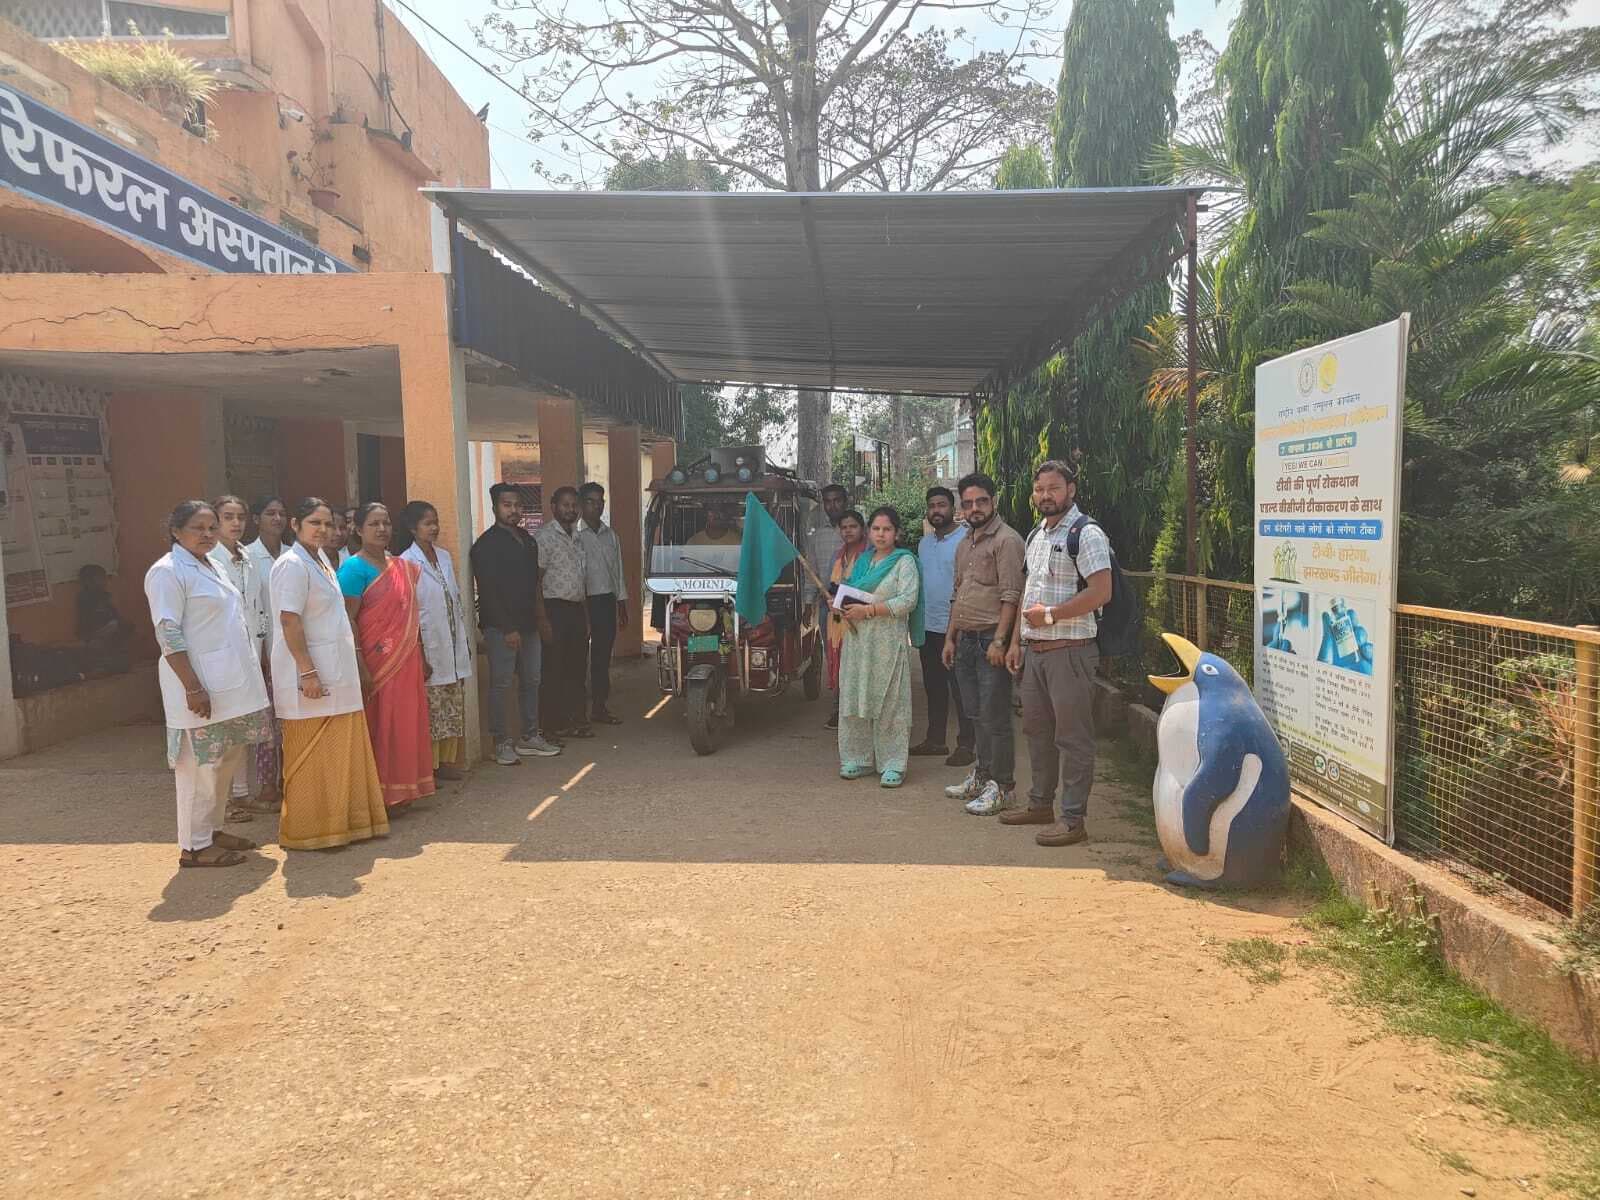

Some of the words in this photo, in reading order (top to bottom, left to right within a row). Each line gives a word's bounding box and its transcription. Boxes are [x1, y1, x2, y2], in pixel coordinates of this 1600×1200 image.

[1276, 477, 1292, 492] टीबी
[1294, 475, 1304, 490] की
[1306, 497, 1348, 513] टीकाकरण
[1349, 496, 1360, 512] के
[1361, 498, 1383, 513] साथ
[683, 579, 725, 590] MORNI
